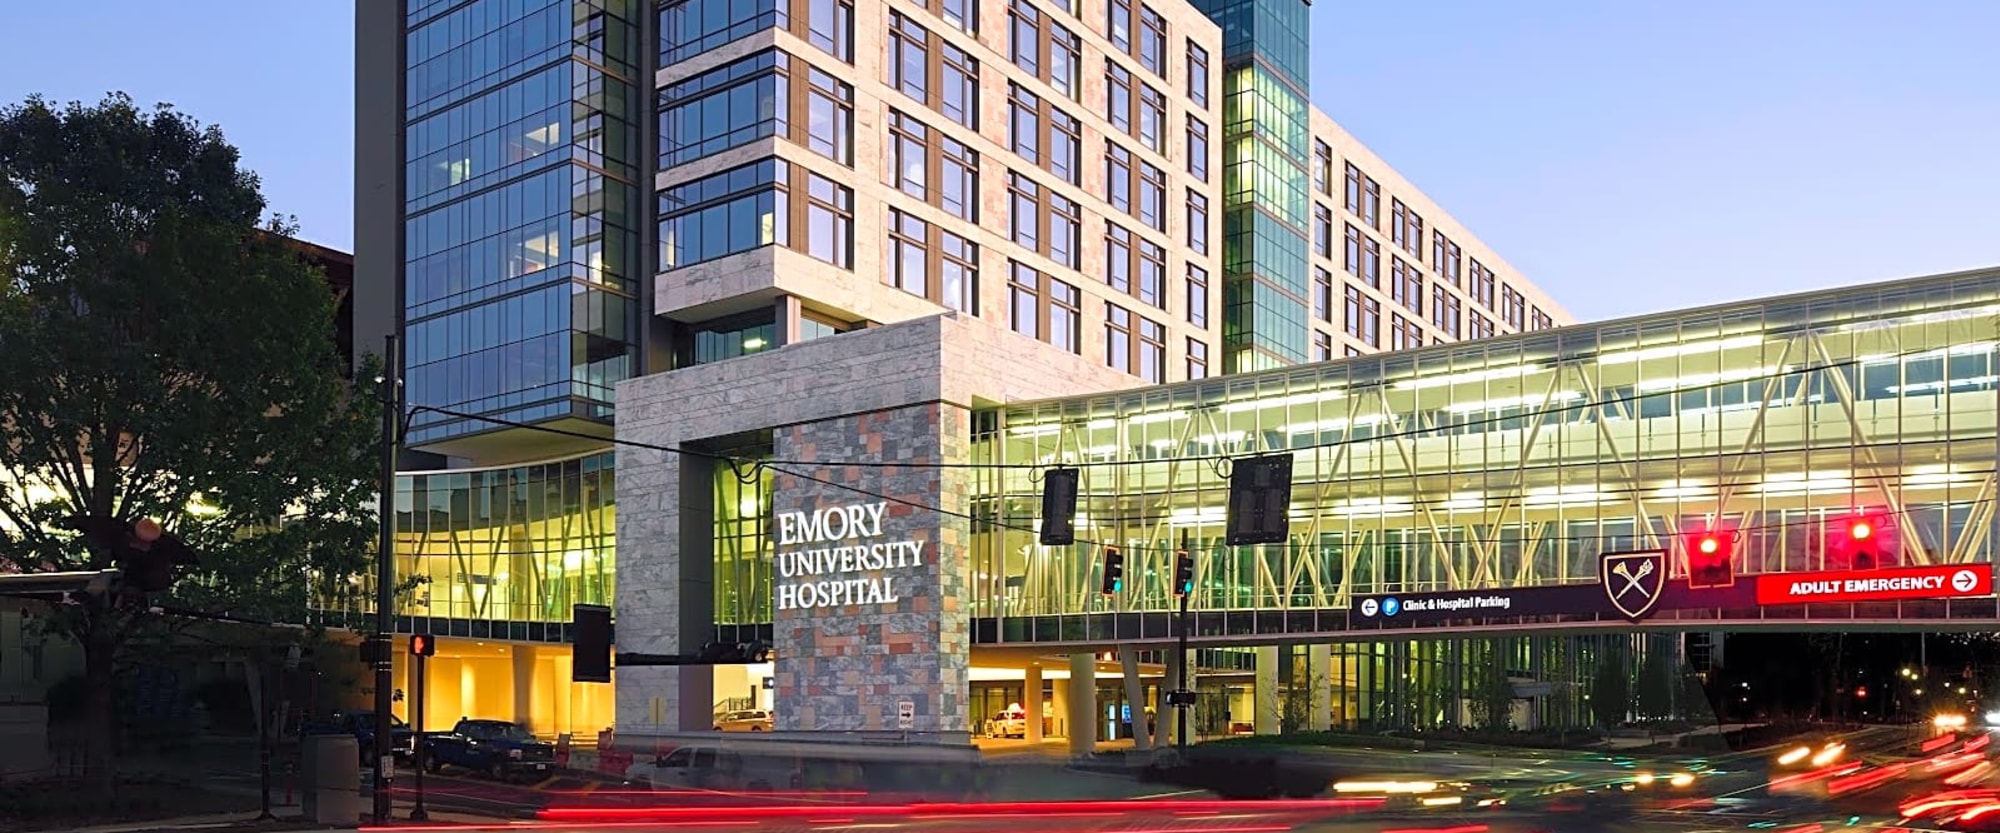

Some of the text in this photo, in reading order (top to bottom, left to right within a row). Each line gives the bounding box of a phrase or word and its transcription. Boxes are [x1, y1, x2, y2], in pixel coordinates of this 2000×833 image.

[778, 501, 887, 545] EMORY
[778, 540, 925, 578] UNIVERSITY
[778, 577, 898, 610] HOSPITAL
[1790, 575, 1945, 595] ADULT EMERGENCY
[1386, 596, 1510, 612] P Clinic & Hospital Parking
